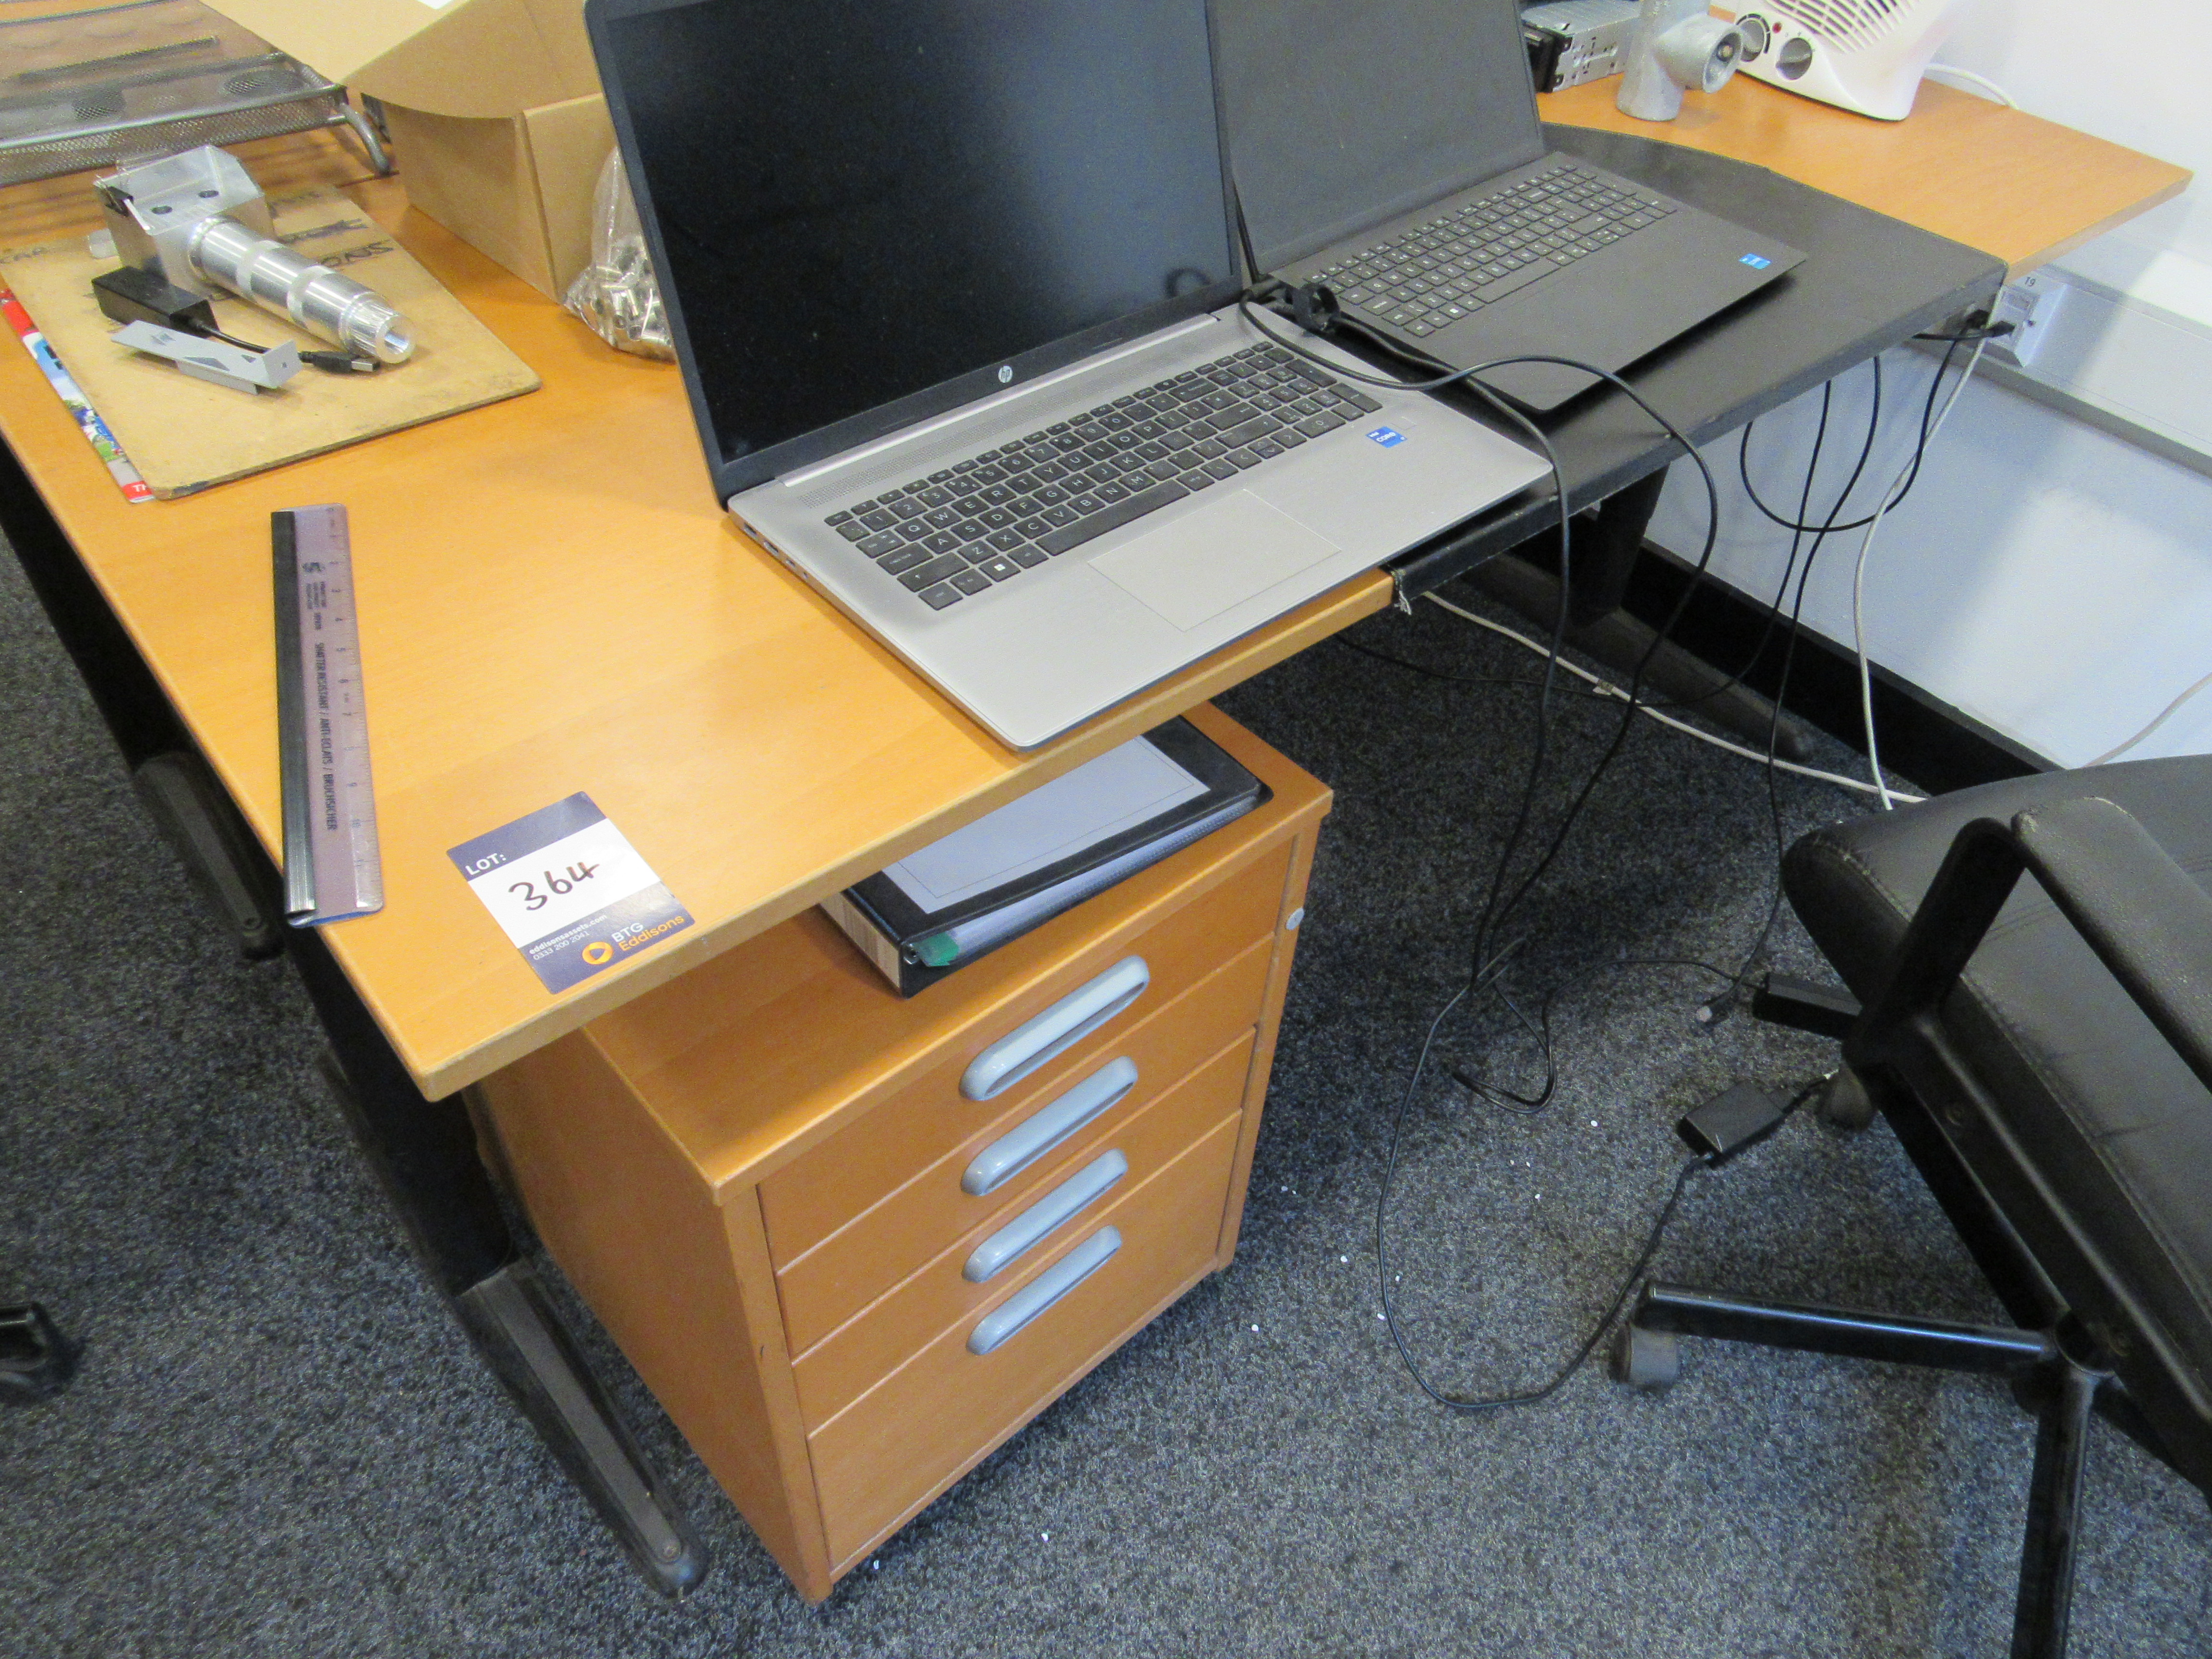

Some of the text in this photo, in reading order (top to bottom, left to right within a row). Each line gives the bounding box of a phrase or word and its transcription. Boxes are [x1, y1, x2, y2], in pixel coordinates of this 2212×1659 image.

[998, 366, 1012, 383] hp
[1130, 476, 1143, 484] M
[934, 512, 948, 521] W
[465, 853, 506, 875] LOT:
[508, 862, 600, 911] 364
[529, 914, 607, 954] eddisonsassets.com
[612, 923, 643, 942] BTG
[618, 915, 685, 951] Eddisons
[533, 931, 589, 960] 0333 200 2041
